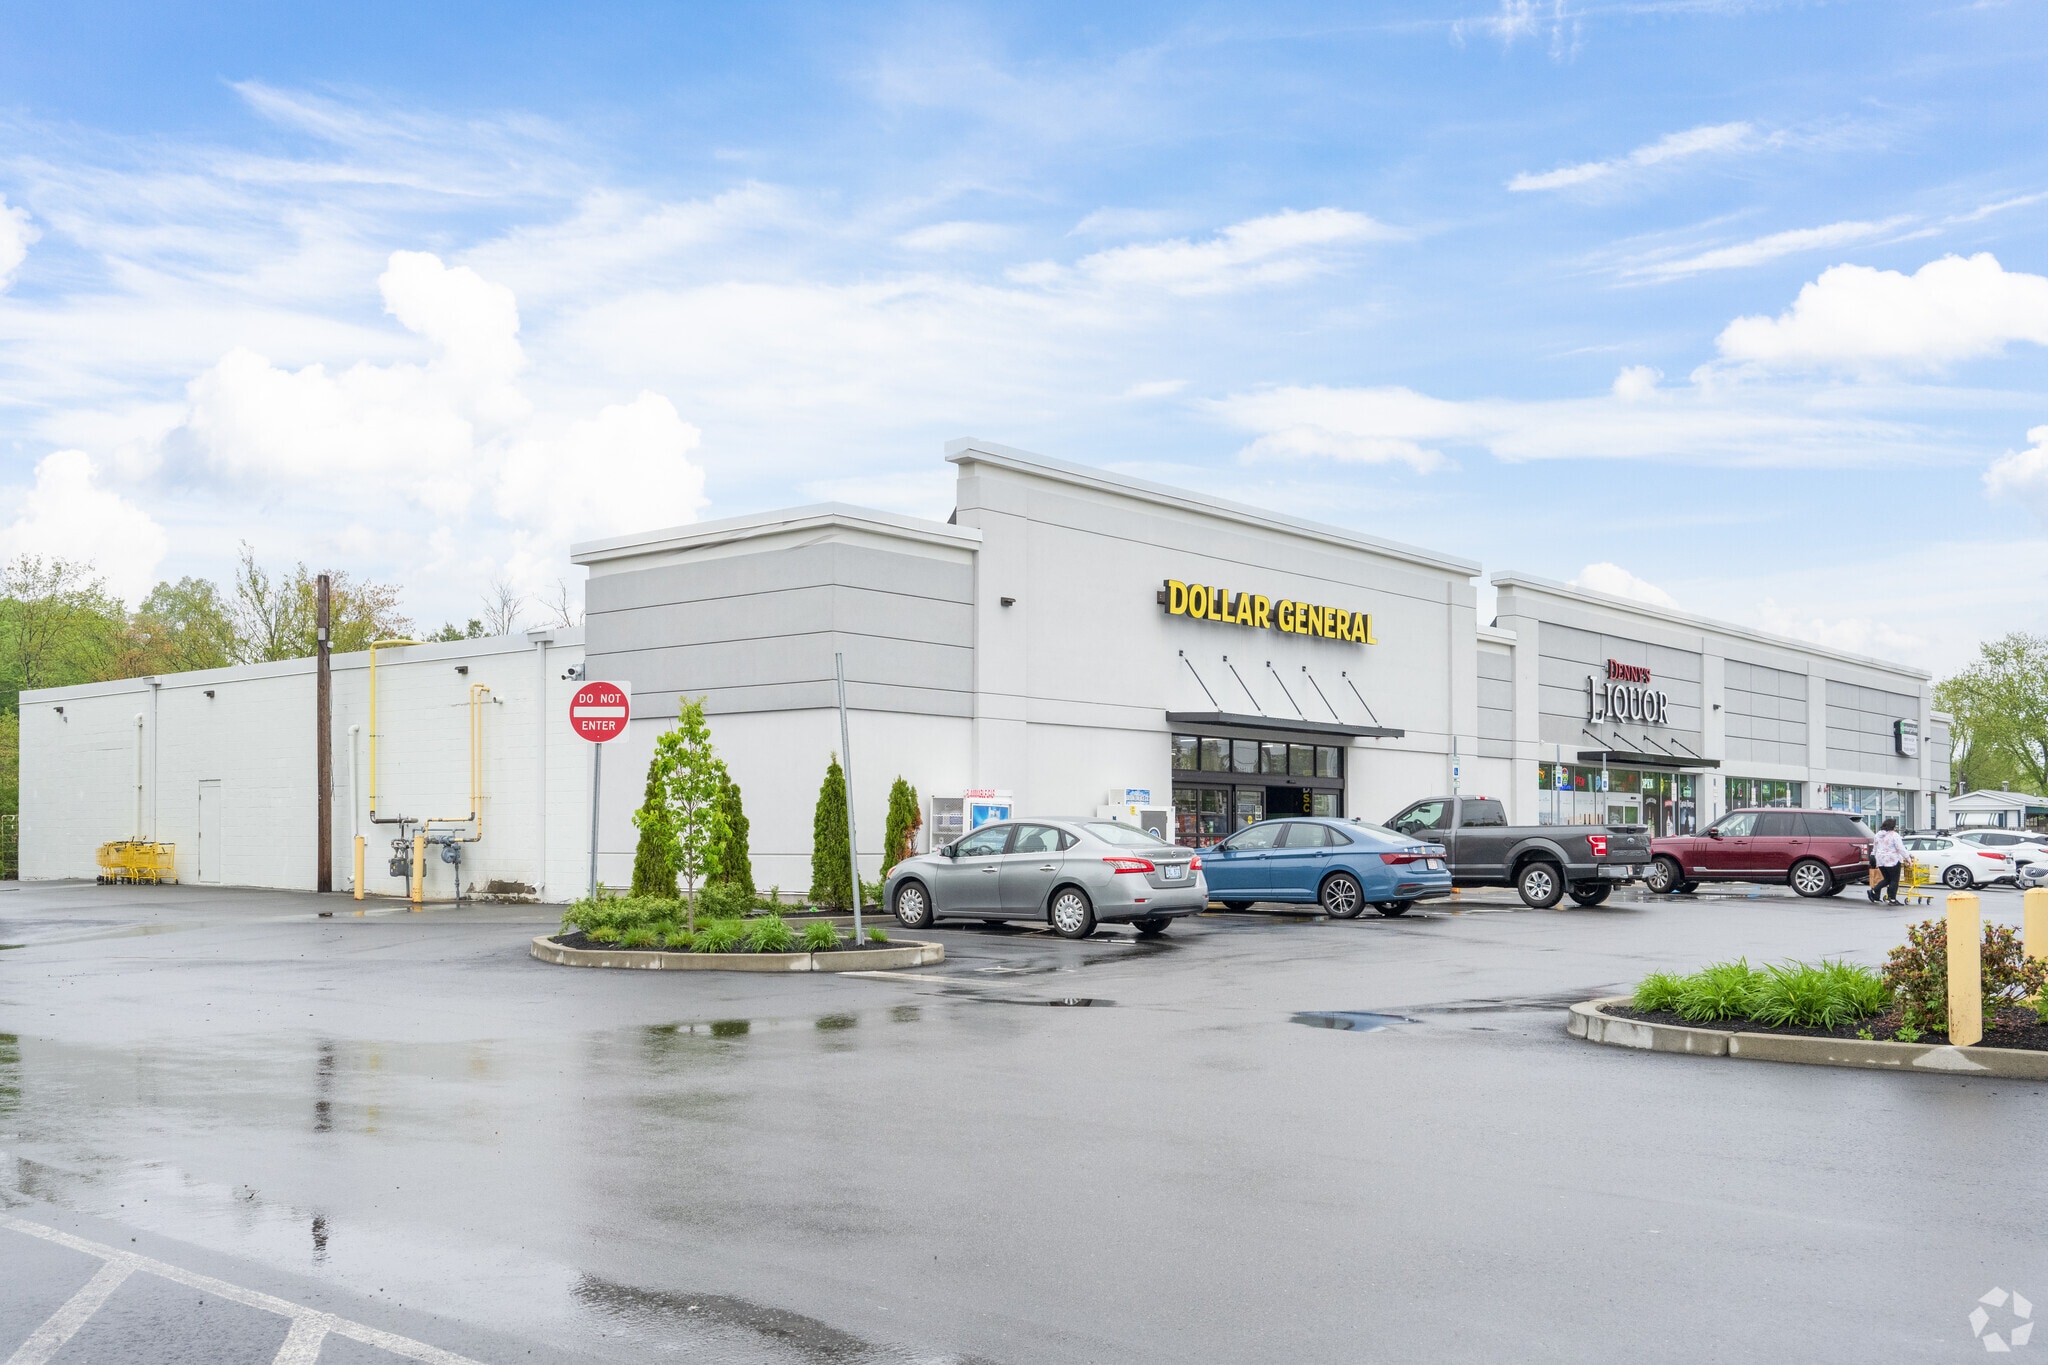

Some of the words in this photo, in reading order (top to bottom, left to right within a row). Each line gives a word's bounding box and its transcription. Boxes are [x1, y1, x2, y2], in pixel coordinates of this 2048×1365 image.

[1165, 579, 1271, 629] DOLLAR
[1275, 599, 1378, 645] GENERAL
[1607, 659, 1651, 684] DENNY'S
[579, 693, 594, 704] DO
[600, 693, 621, 704] NOT
[1588, 675, 1670, 724] LIQUOR
[581, 720, 616, 731] ENTER
